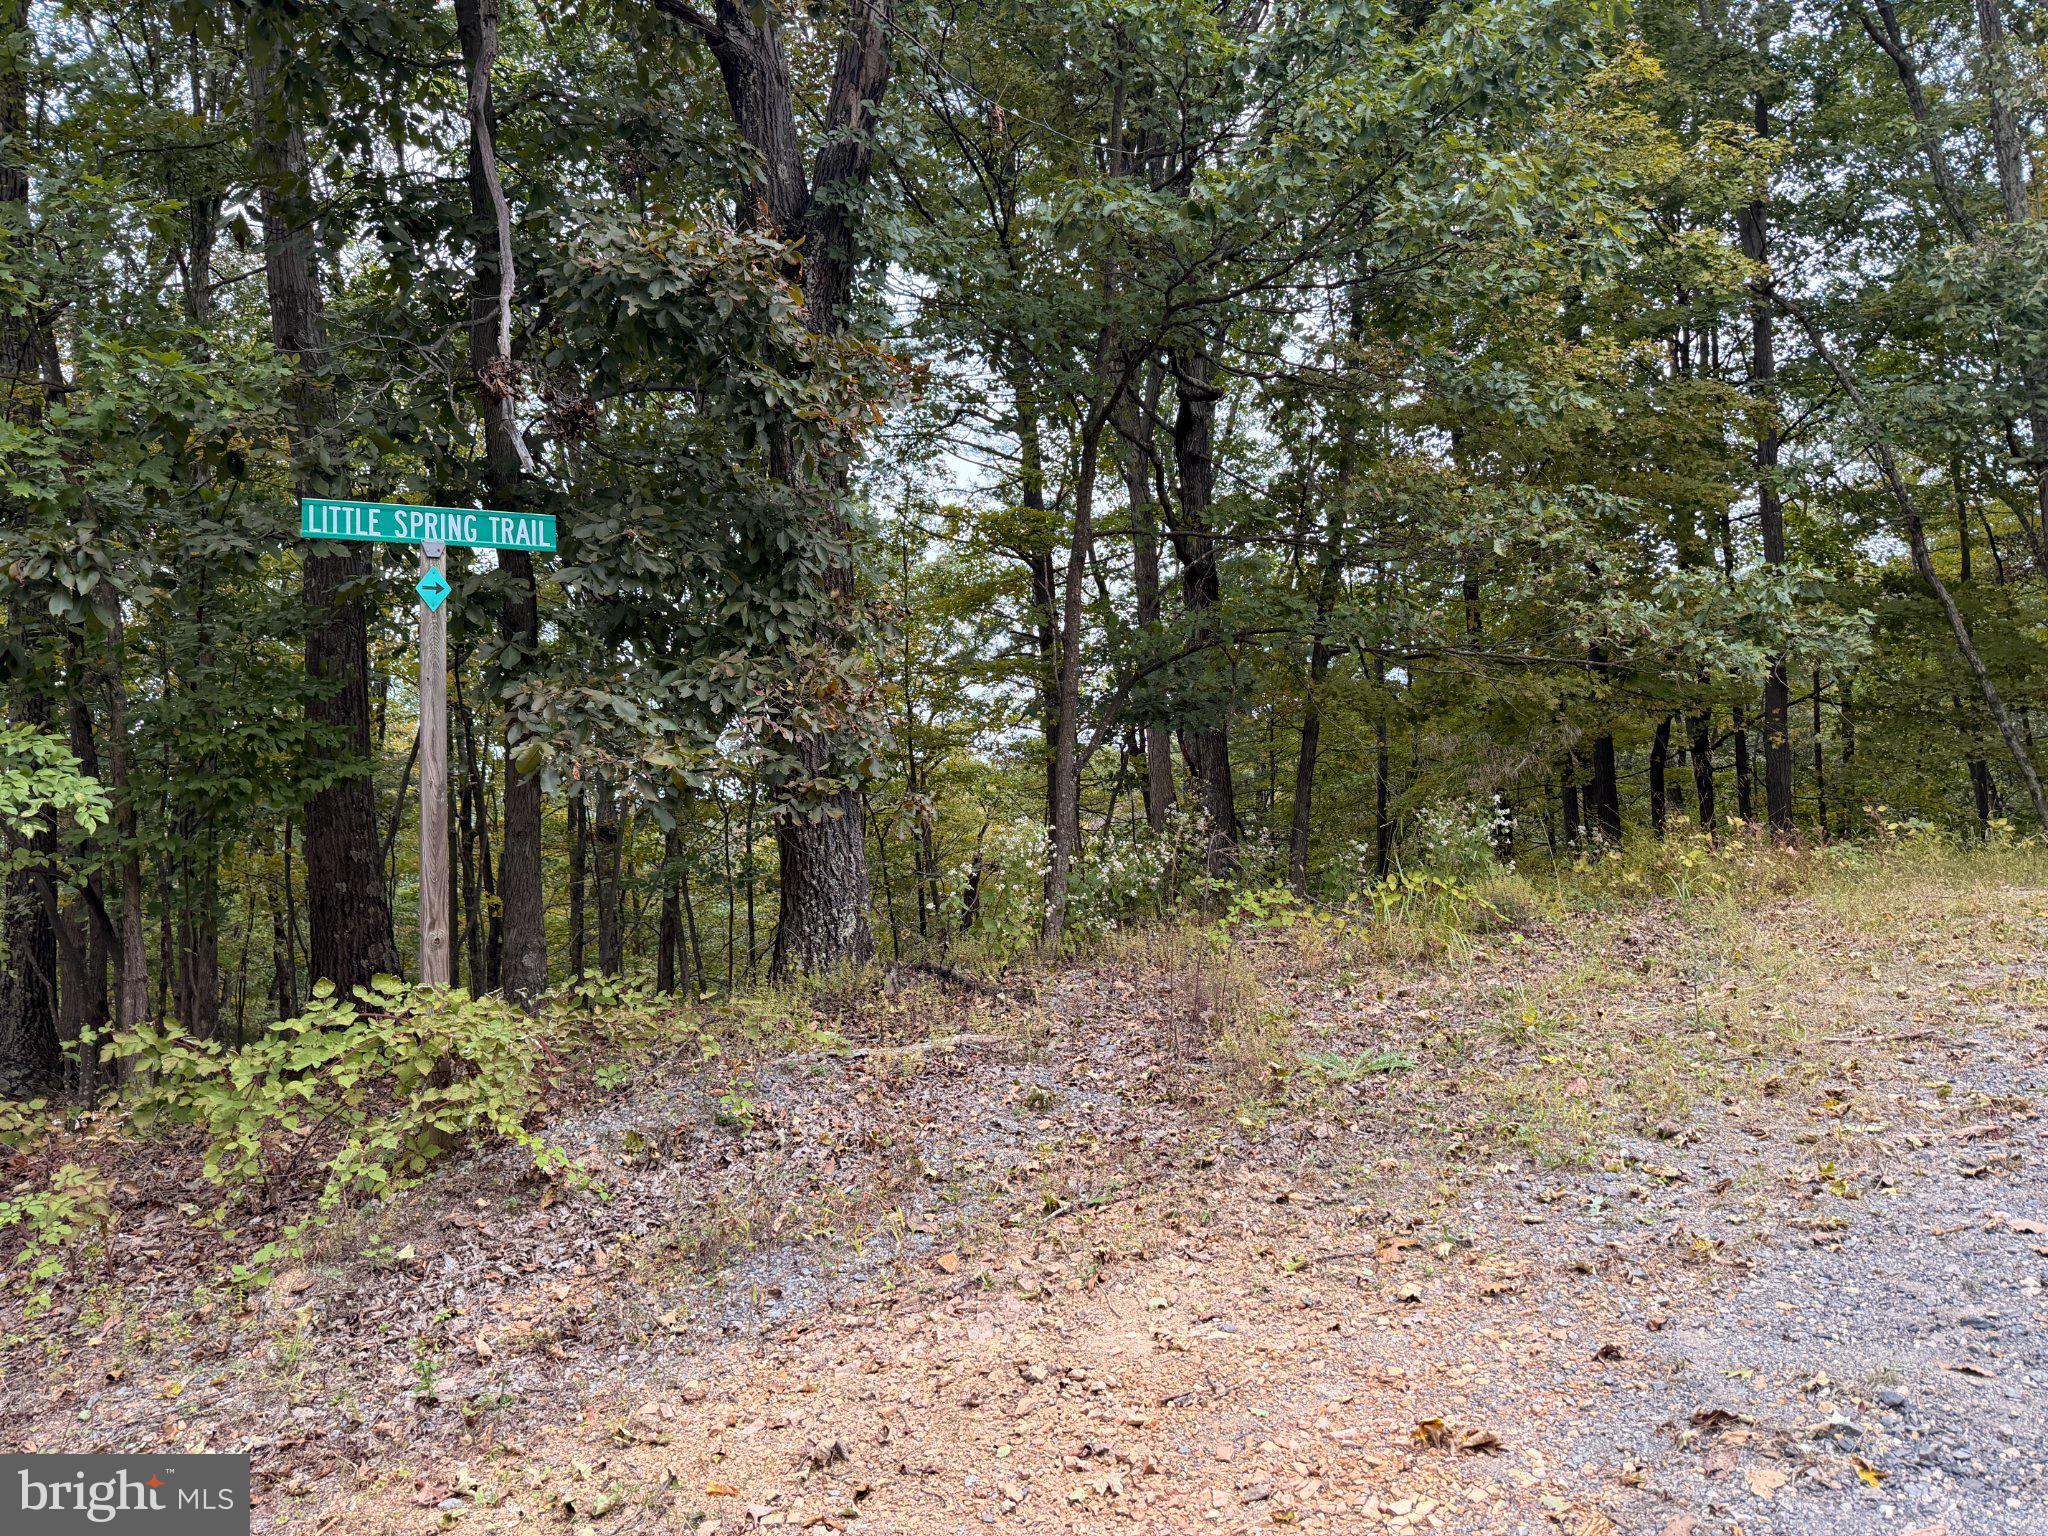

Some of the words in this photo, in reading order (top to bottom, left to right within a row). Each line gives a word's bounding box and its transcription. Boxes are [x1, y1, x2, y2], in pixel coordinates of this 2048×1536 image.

[308, 504, 381, 536] LITTLE
[394, 510, 477, 542] SPRING
[489, 516, 551, 547] TRAIL
